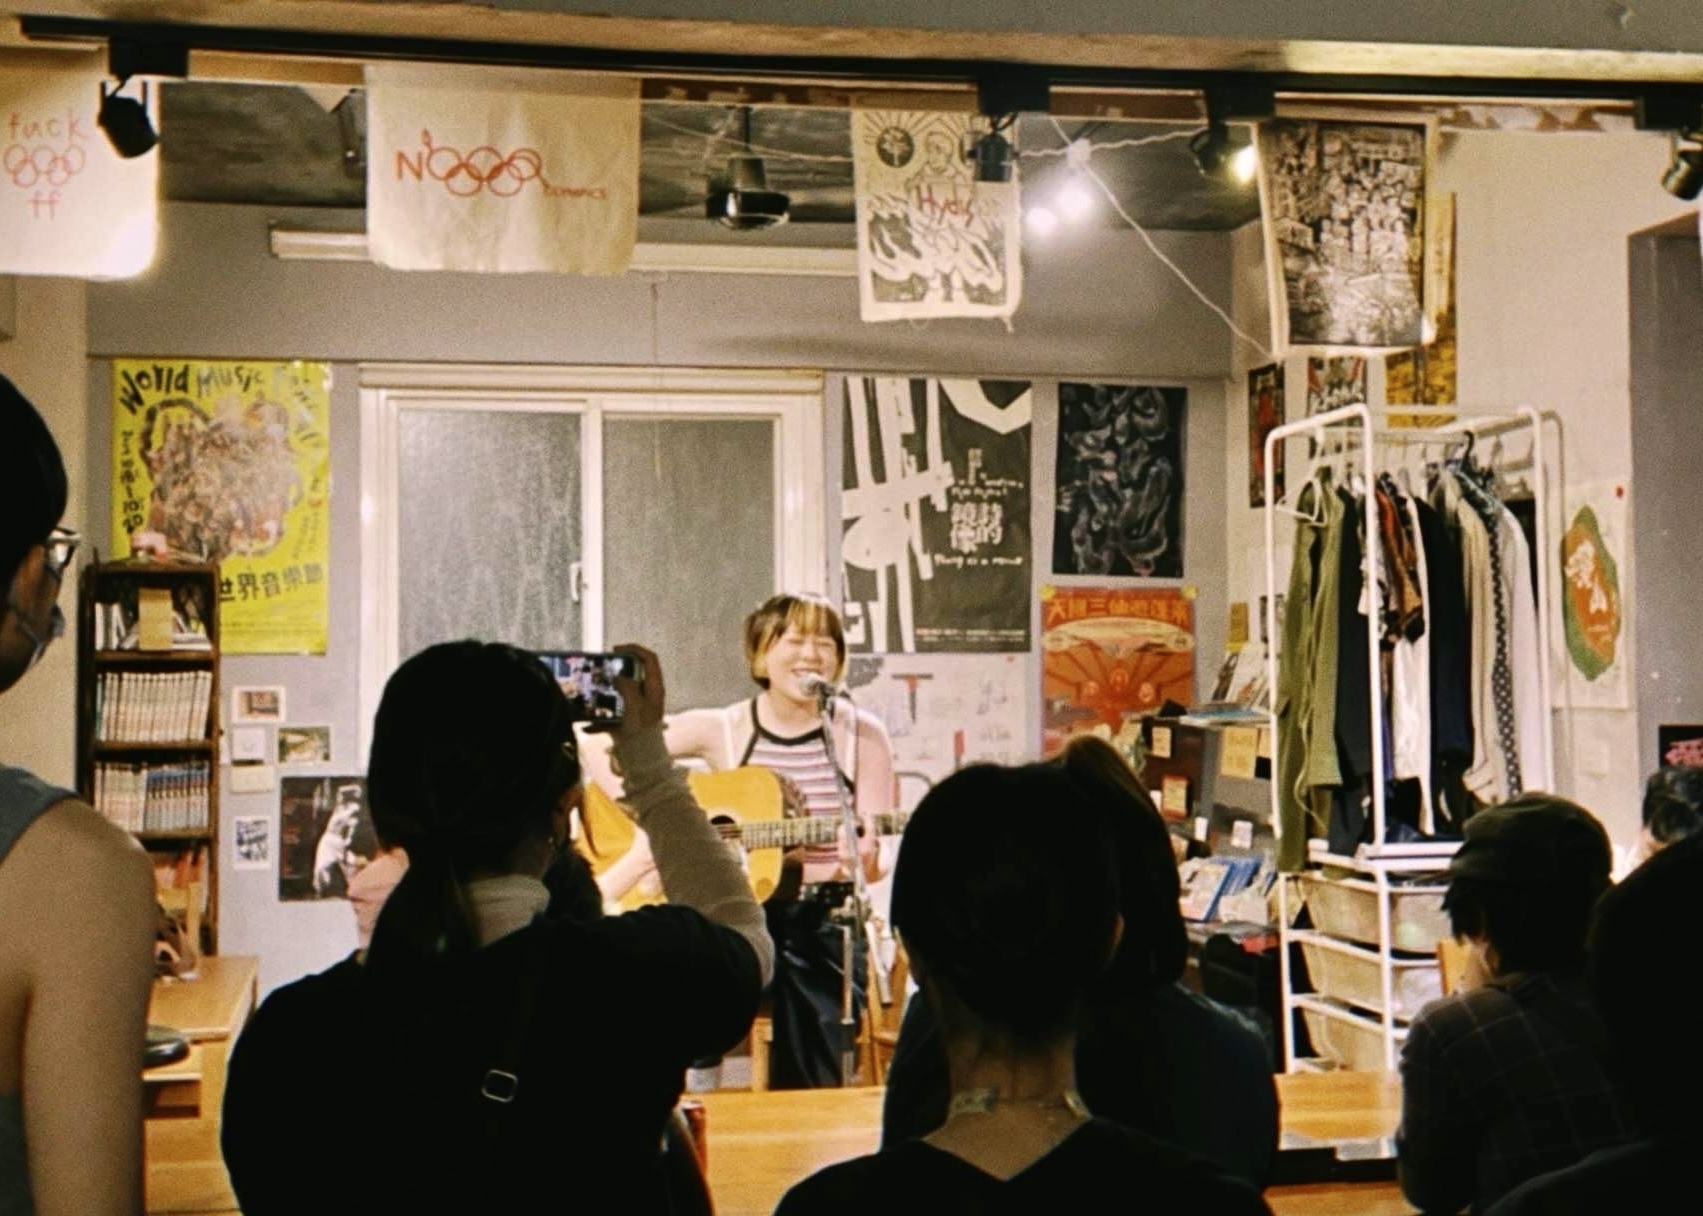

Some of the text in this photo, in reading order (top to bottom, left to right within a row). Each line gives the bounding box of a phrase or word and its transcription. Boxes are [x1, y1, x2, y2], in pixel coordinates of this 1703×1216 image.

[8, 110, 90, 142] fuck
[119, 364, 190, 415] World
[197, 365, 265, 398] Music
